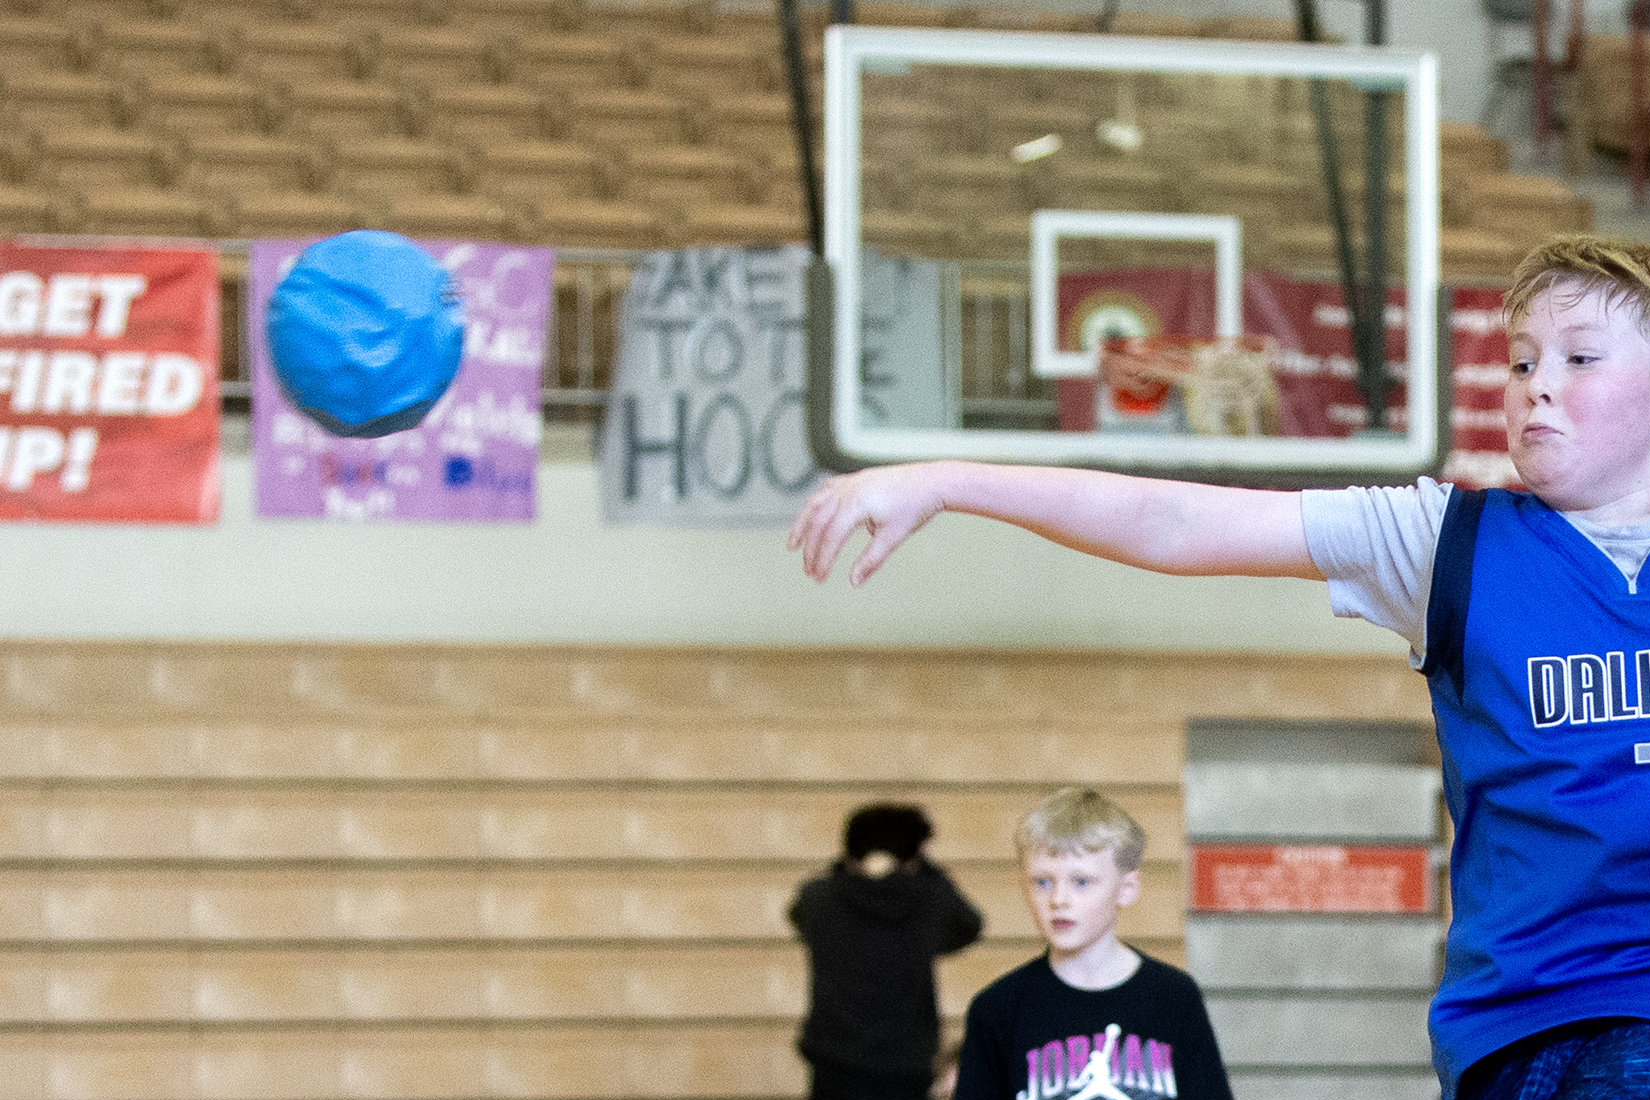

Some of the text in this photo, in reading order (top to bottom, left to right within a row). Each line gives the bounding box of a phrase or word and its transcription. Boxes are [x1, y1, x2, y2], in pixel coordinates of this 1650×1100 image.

[0, 270, 149, 338] GET
[640, 315, 894, 388] TO TE
[620, 392, 888, 500] HOO
